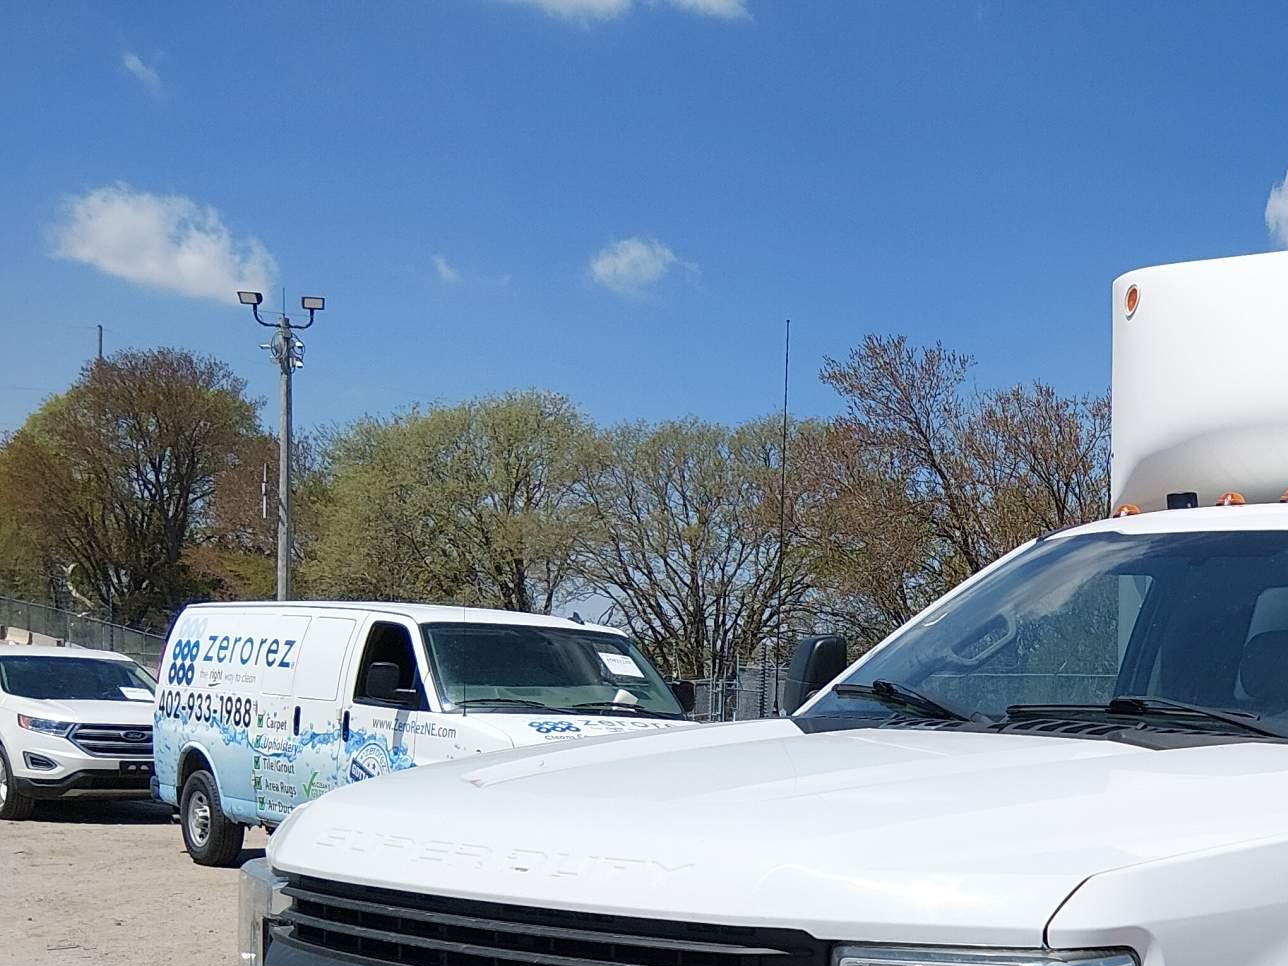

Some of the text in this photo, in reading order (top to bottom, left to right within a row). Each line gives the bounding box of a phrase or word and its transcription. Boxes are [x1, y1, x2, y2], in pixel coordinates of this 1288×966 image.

[203, 635, 296, 668] zerorez
[209, 669, 223, 683] right
[241, 671, 257, 684] clean
[159, 690, 252, 728] 402-933-1988
[266, 716, 288, 731] Carpet
[372, 718, 457, 739] www.ZeroRezNE.com
[262, 737, 298, 756] Upholstery
[263, 758, 295, 774] Tile/Grout
[265, 779, 280, 793] Area
[280, 782, 297, 798] Rugs
[268, 799, 295, 815] Air Duc
[312, 824, 697, 892] SUPER DUTY
